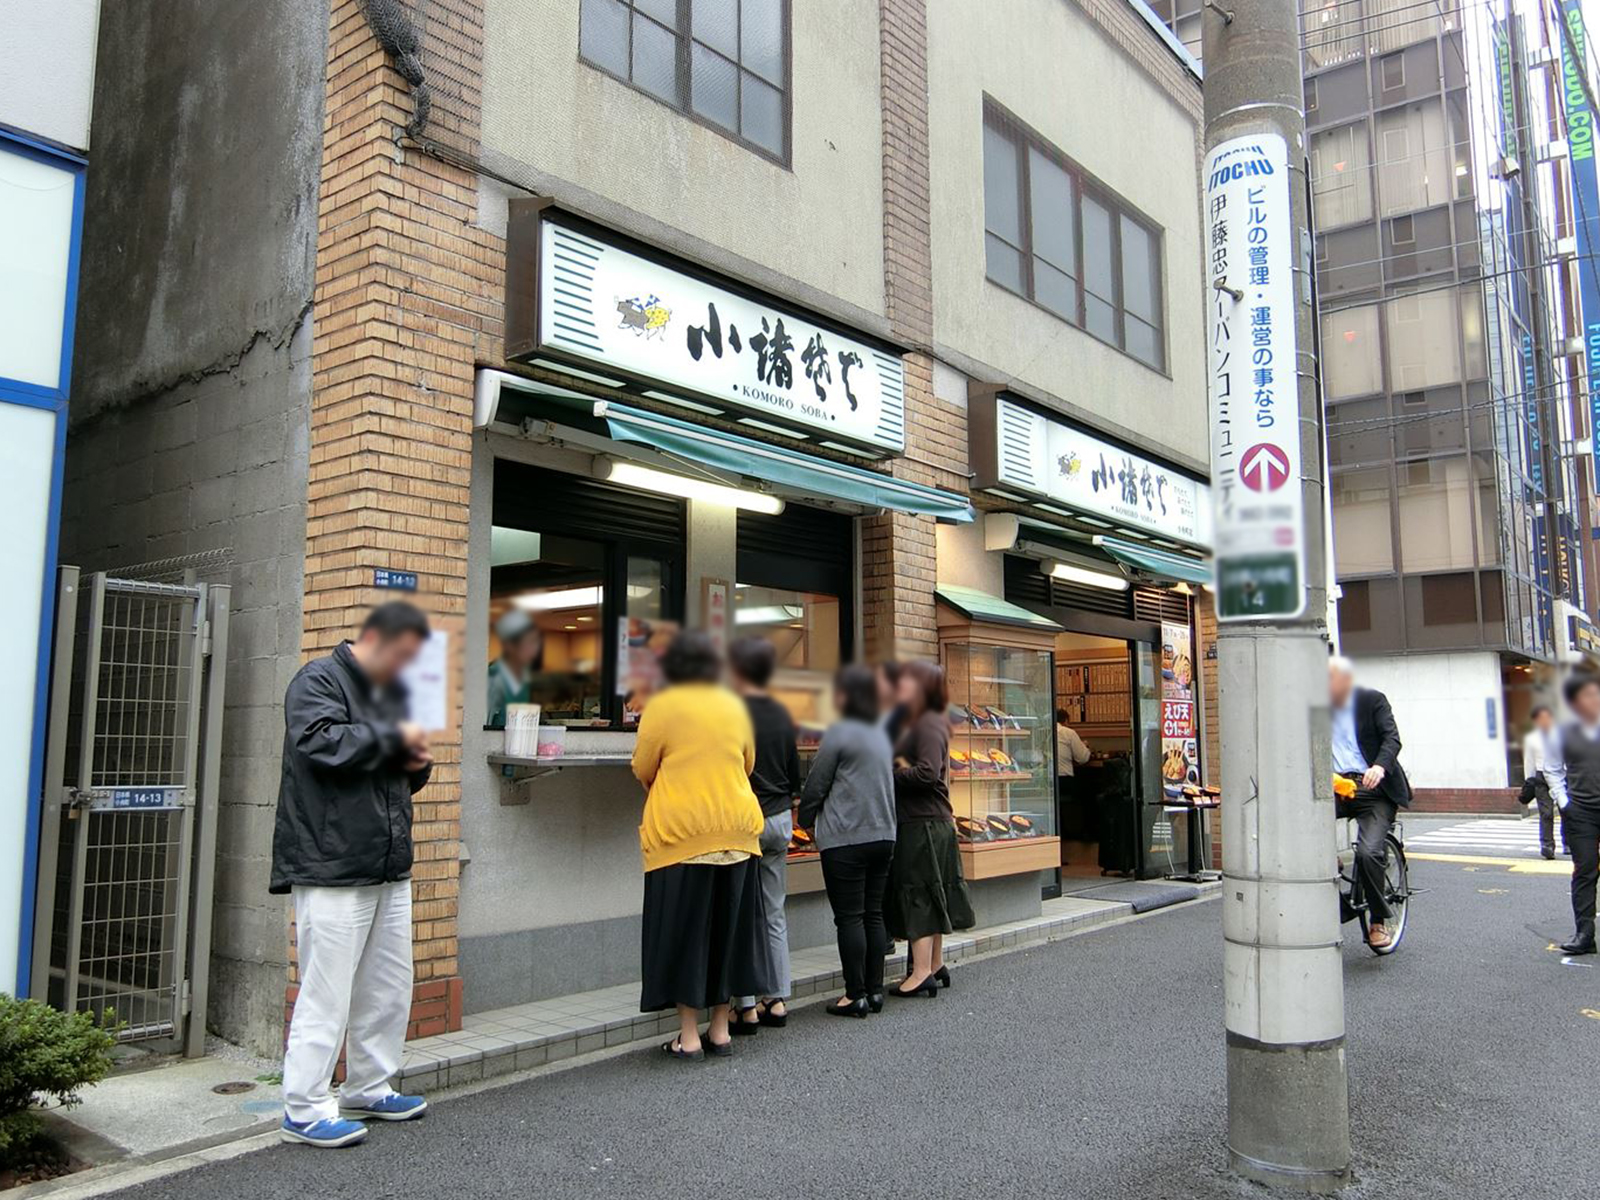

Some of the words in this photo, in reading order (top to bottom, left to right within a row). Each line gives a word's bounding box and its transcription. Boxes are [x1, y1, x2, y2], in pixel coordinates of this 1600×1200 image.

[1208, 155, 1274, 192] ITOCHU
[1247, 185, 1275, 428] ビルの管理・運営の事なら
[742, 385, 794, 411] KOMORO
[800, 402, 829, 421] SOBA
[1164, 703, 1189, 720] えび天
[134, 793, 161, 803] 14-13
